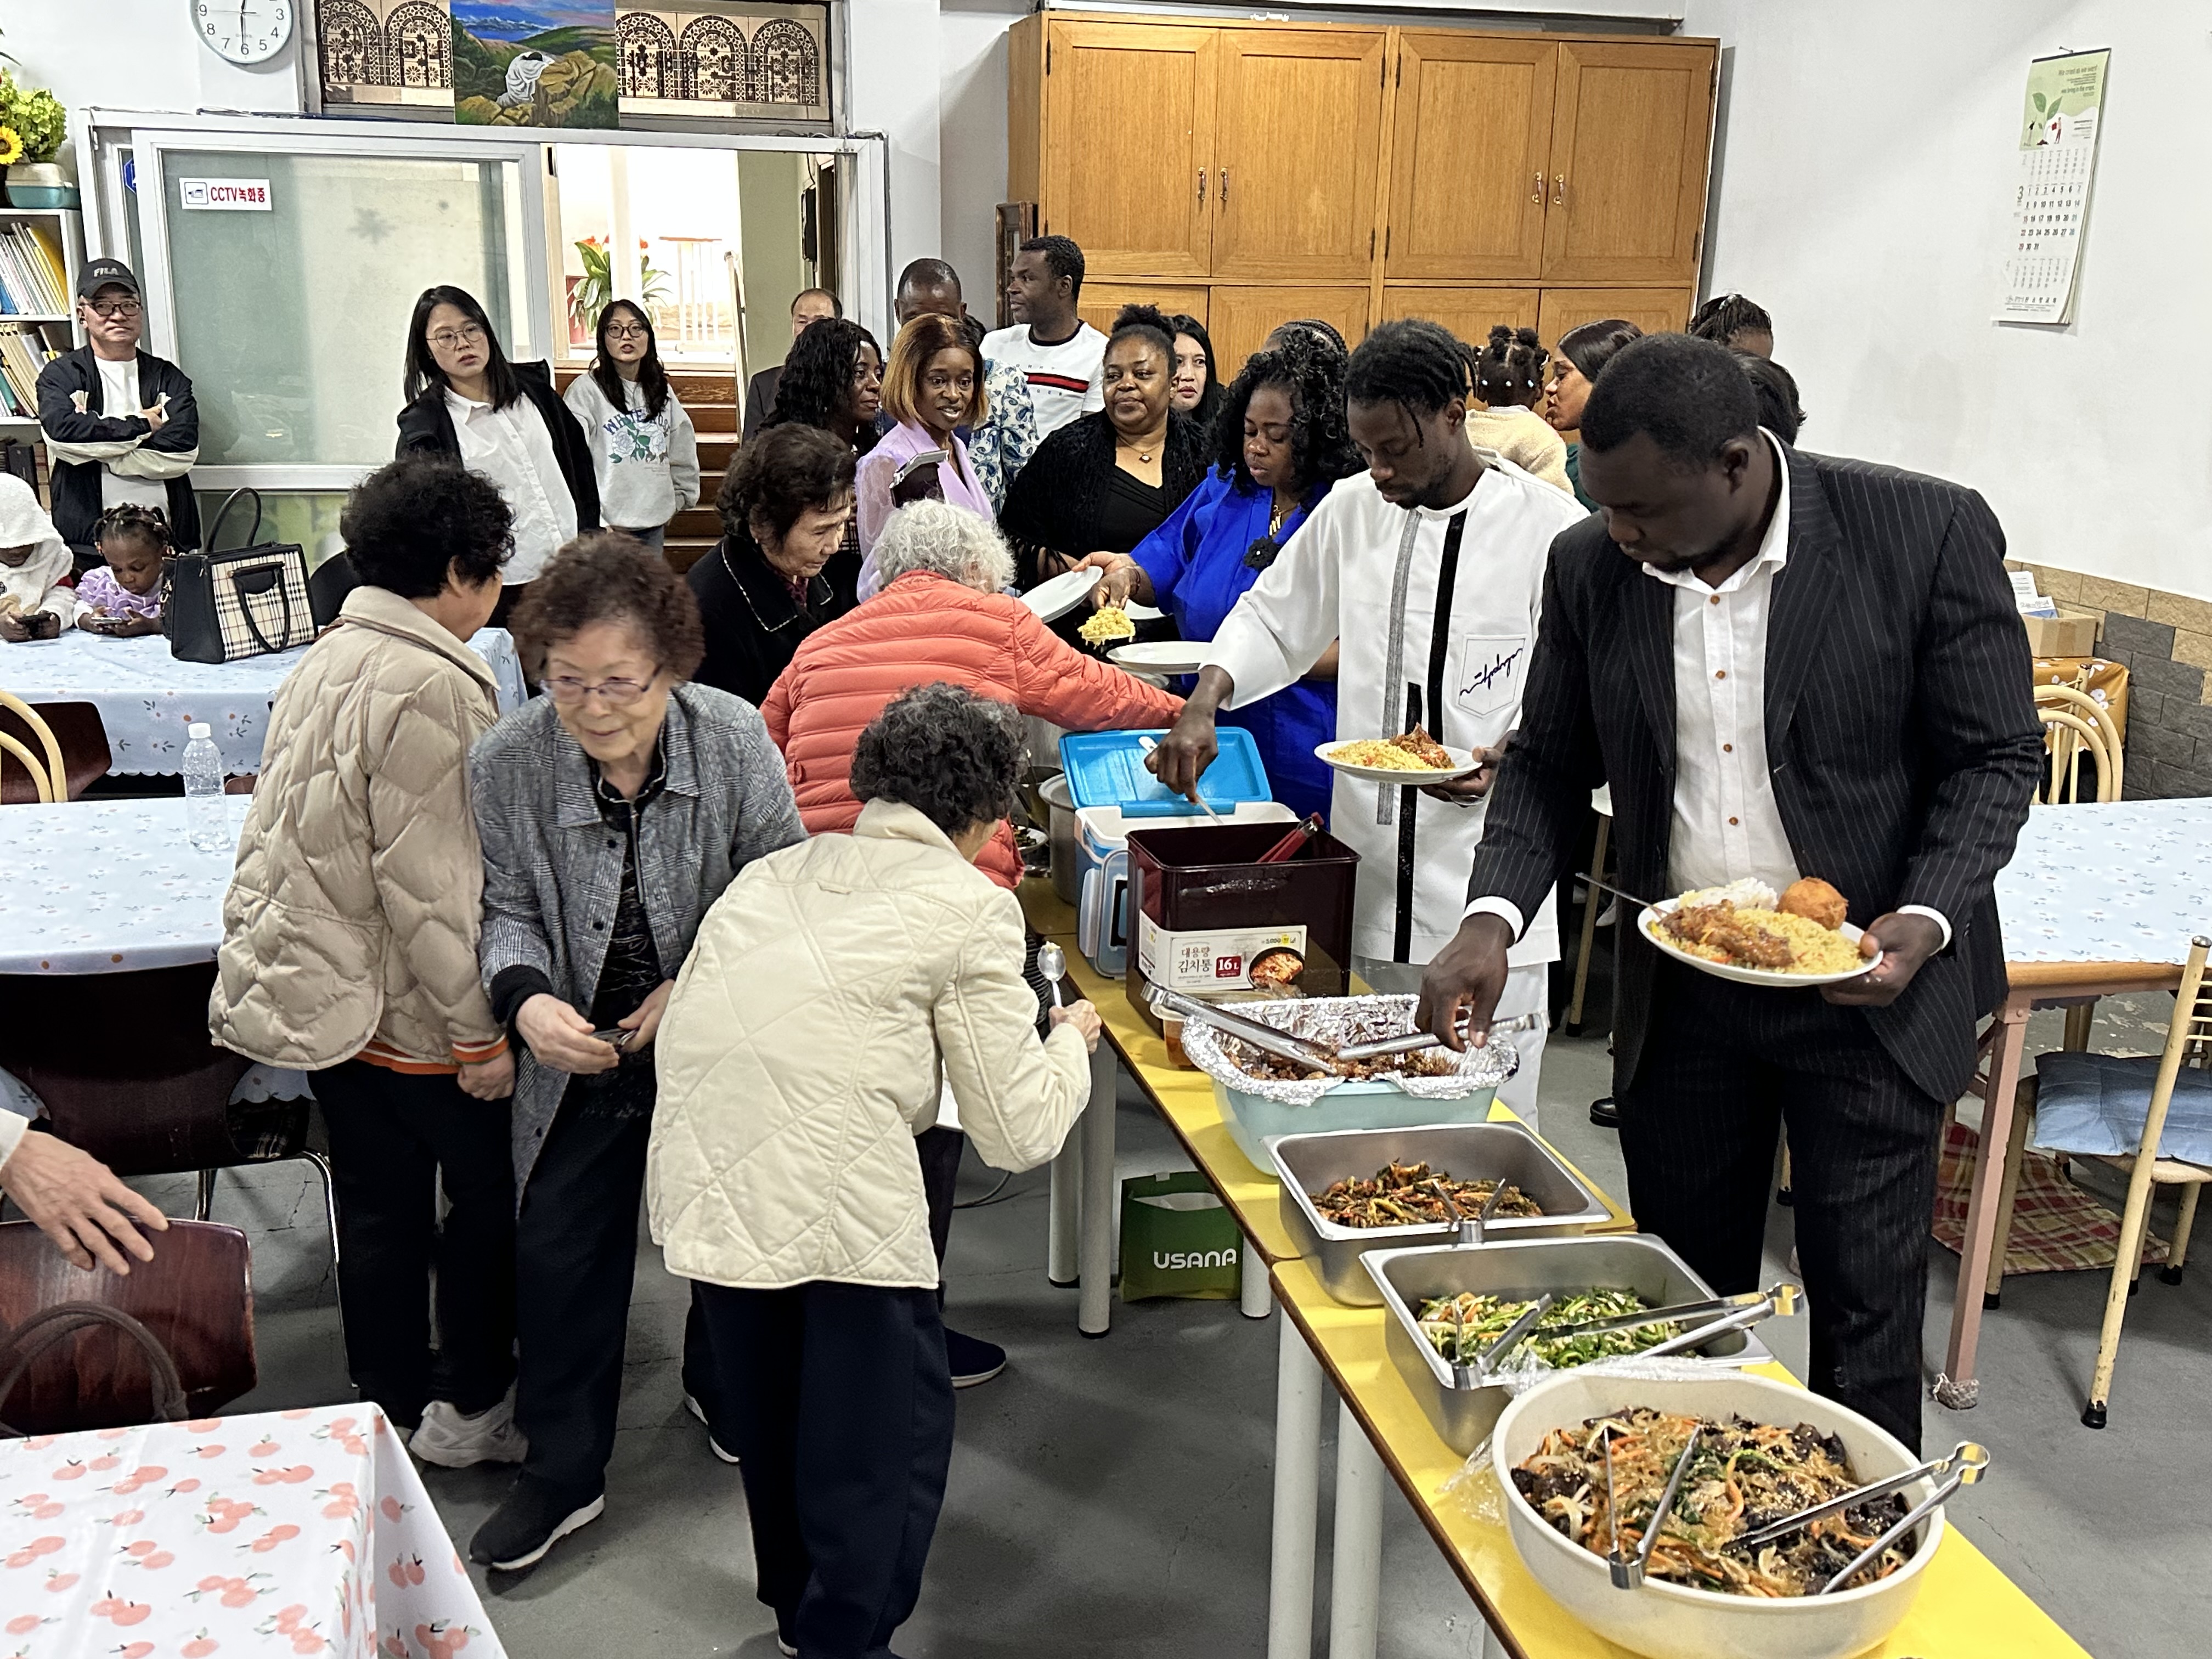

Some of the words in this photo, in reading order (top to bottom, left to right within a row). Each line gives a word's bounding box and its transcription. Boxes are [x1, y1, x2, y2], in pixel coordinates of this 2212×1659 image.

[199, 4, 207, 16] 9
[276, 8, 284, 20] 3
[207, 23, 215, 35] 8
[270, 27, 279, 38] 4
[221, 38, 230, 49] 7
[241, 43, 249, 55] 6
[259, 40, 267, 50] 5
[2017, 185, 2024, 200] 3
[2078, 185, 2081, 193] 7
[93, 267, 119, 277] FILA
[1181, 946, 1211, 958] 대용량
[1178, 959, 1212, 973] 김치통
[1153, 1248, 1237, 1269] USANA
